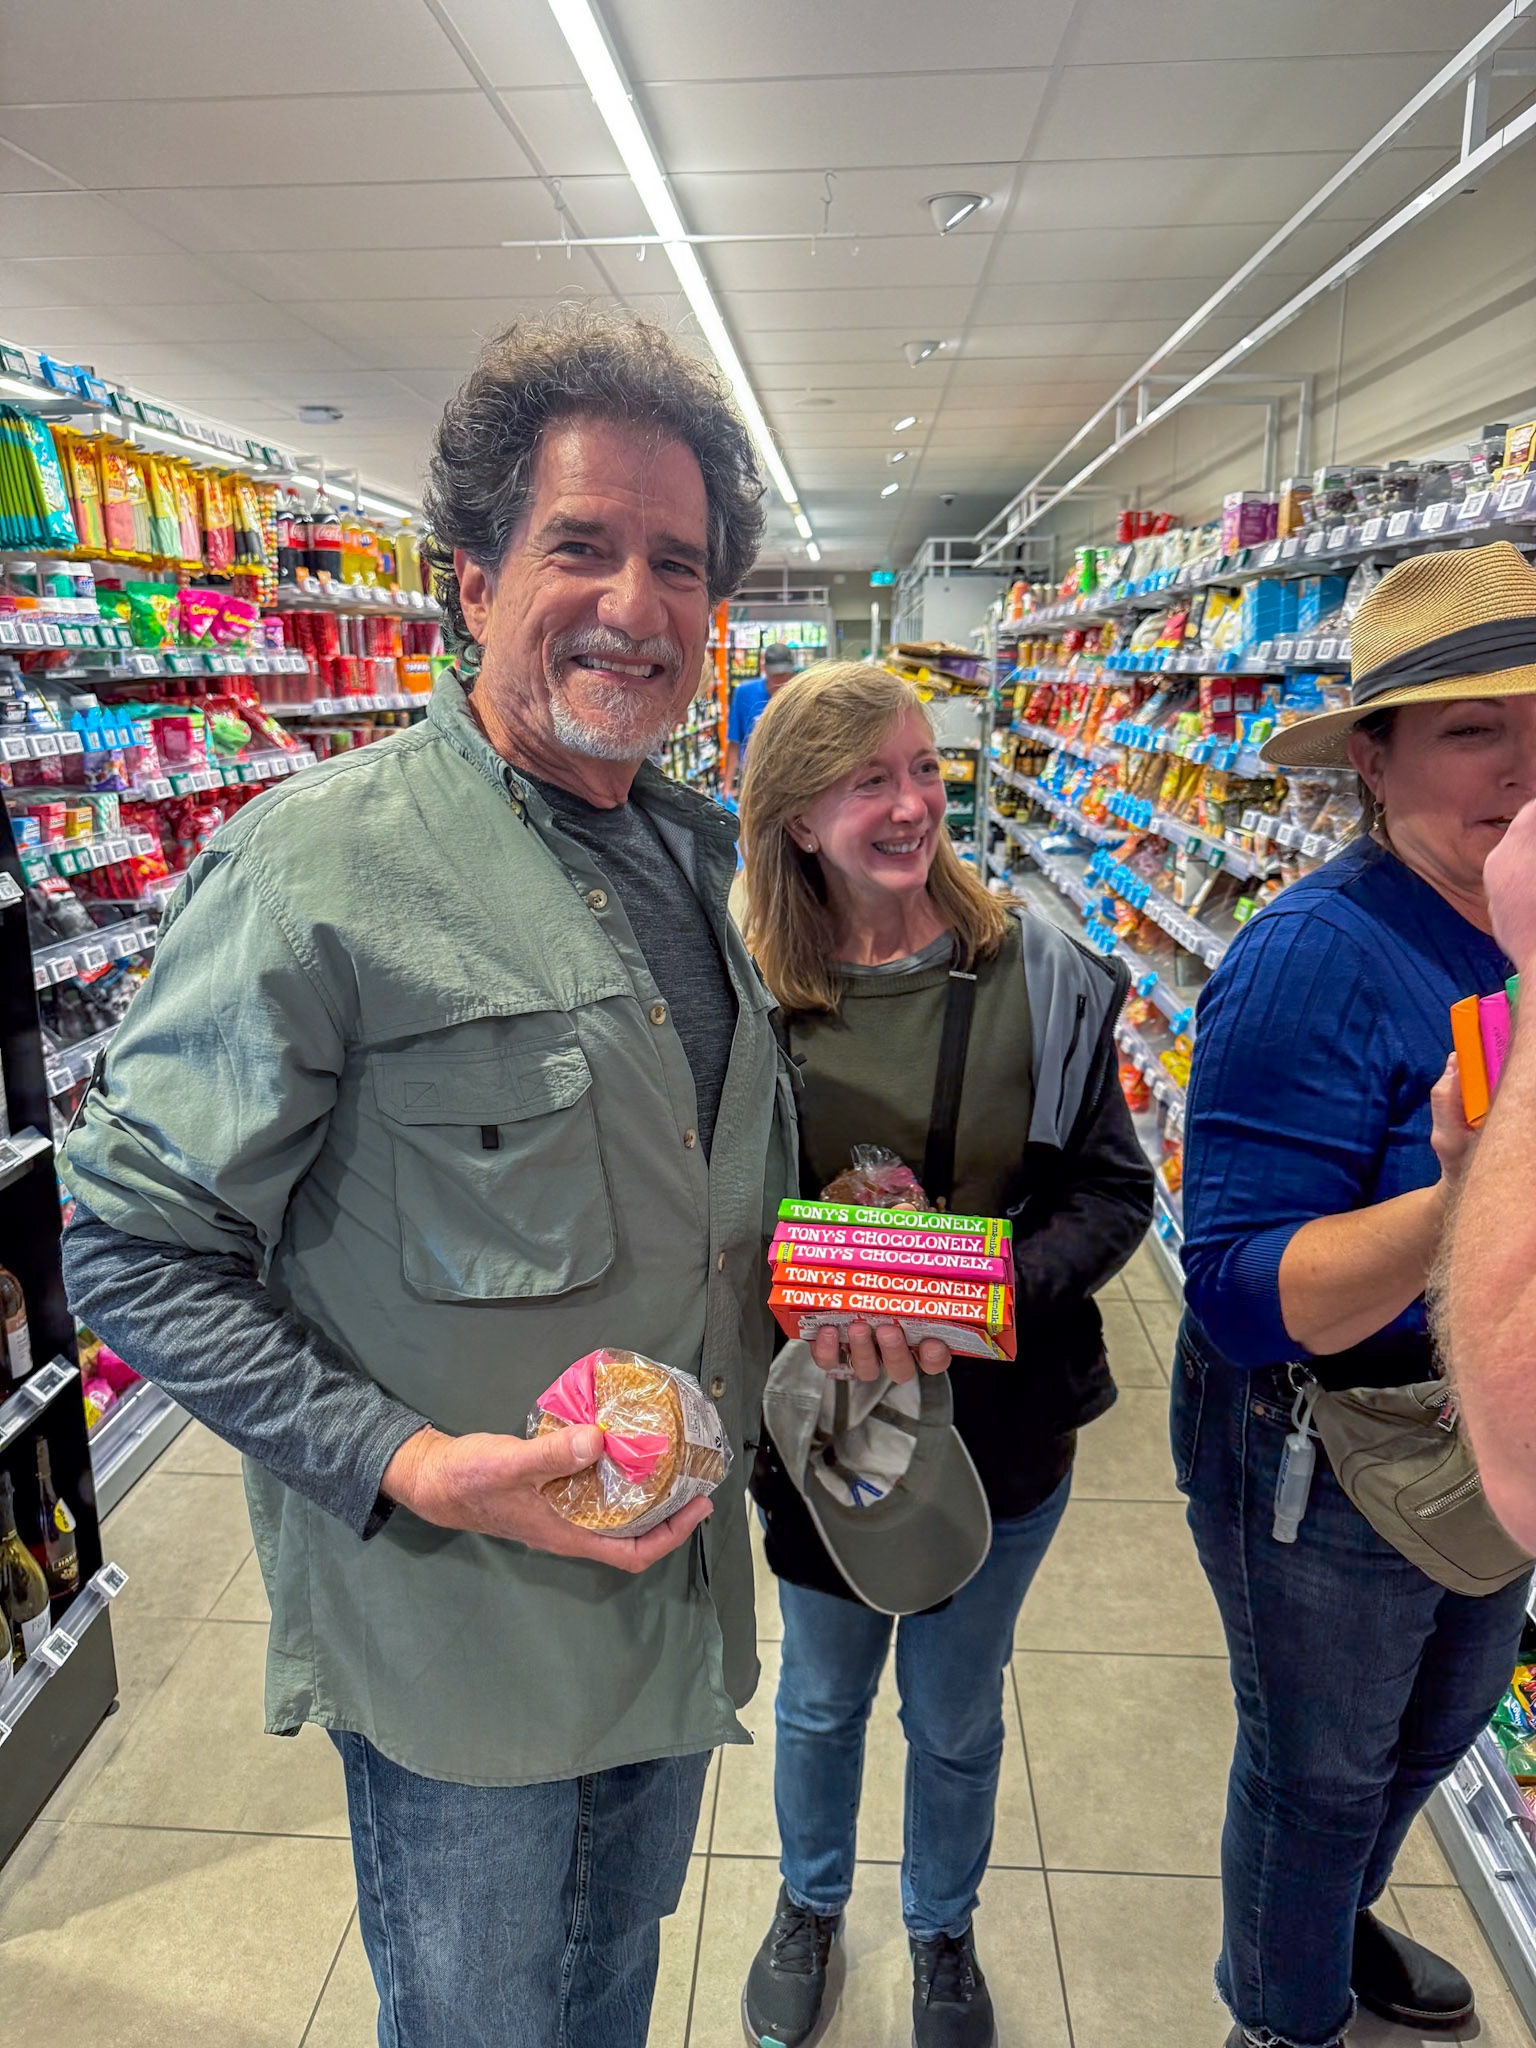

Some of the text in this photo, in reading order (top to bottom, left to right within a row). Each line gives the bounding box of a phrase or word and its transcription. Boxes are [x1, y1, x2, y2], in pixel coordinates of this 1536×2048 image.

[790, 1204, 983, 1233] TONY'S CHOCOLONELY
[787, 1226, 981, 1252] TONY'S CHOCOLONELY
[794, 1245, 854, 1261] TONY'S
[859, 1248, 992, 1270] CHOCOLONELY
[785, 1267, 985, 1299] TONY'S CHOCOLONELY
[782, 1289, 983, 1319] TONY'S CHOCOLONELY
